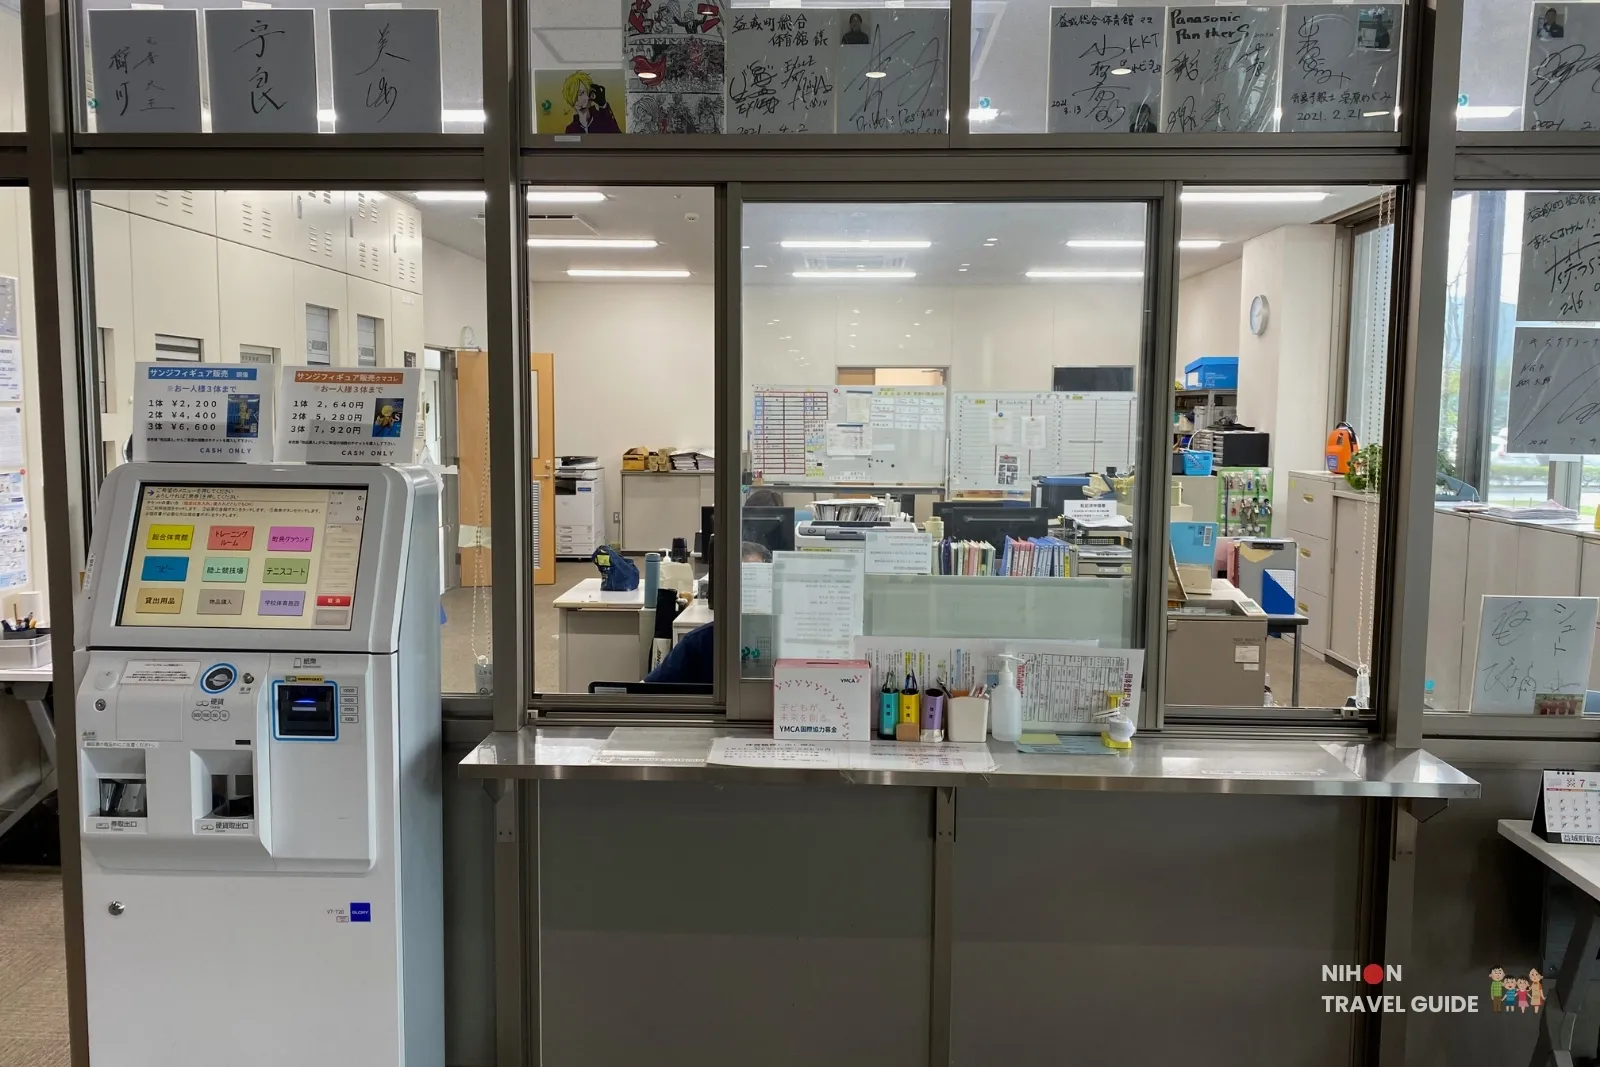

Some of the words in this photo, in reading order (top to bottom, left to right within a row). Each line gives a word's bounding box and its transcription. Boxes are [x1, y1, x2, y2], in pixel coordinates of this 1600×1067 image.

[1171, 9, 1241, 28] Panasonic
[150, 368, 229, 378] サンジフィギュア販売
[148, 399, 164, 407] 1体
[148, 411, 163, 419] 2体
[290, 425, 306, 433] 3体
[152, 533, 189, 541] 総合体育館
[215, 530, 248, 538] トレーニング
[155, 564, 175, 573] コピー
[206, 566, 244, 575] 陸上競技場
[266, 567, 306, 576] テニスコート
[144, 596, 176, 605] 貸出用品
[264, 599, 300, 607] 学校体育施設
